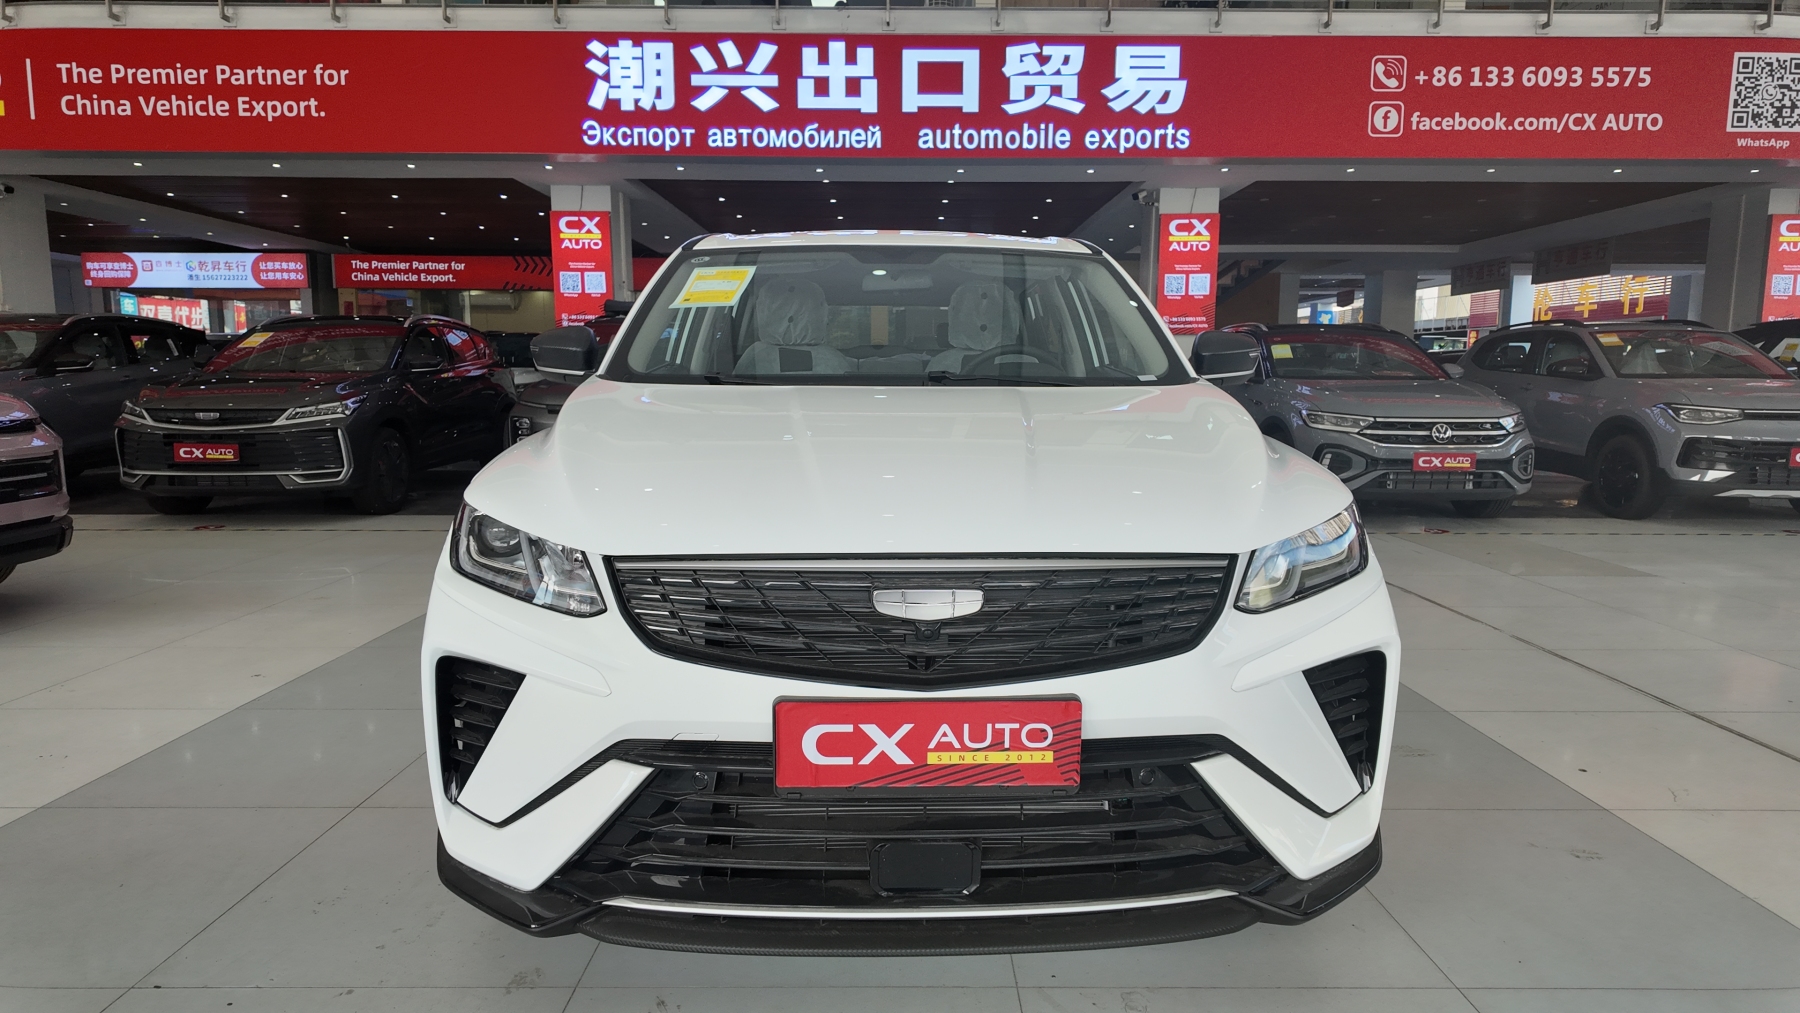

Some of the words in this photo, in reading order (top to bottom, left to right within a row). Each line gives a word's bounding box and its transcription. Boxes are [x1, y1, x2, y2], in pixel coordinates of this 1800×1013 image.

[56, 62, 102, 84] The
[110, 63, 208, 84] Premier
[215, 65, 307, 85] Partner
[313, 64, 349, 85] for
[585, 38, 1188, 115] 潮兴出口贸易
[1414, 66, 1462, 86] +86
[1469, 66, 1515, 86] 133
[1521, 66, 1583, 87] 6093
[1590, 66, 1652, 87] 5575
[60, 94, 132, 115] China
[138, 95, 230, 117] Vehicle
[237, 96, 326, 121] Export.
[1410, 112, 1597, 133] facebook.com/CX
[1602, 113, 1664, 131] AUTO
[582, 120, 695, 151] Экспорт
[707, 123, 882, 149] автомобилей
[917, 122, 1071, 149] automobile
[1084, 122, 1191, 153] exports
[1737, 138, 1790, 149] WhatsApp
[558, 216, 601, 234] CX
[1168, 218, 1211, 236] CX
[1780, 220, 1800, 237] C
[561, 239, 602, 249] AUTO
[1168, 241, 1211, 251] AUTO
[1778, 242, 1800, 251] AU
[351, 260, 369, 269] The
[371, 260, 410, 269] Premier
[412, 261, 449, 270] Partner
[451, 261, 465, 270] for
[351, 272, 380, 281] China
[382, 272, 418, 282] Vehicle
[420, 273, 456, 283] Export.
[179, 448, 204, 458] CX
[1418, 457, 1443, 467] CX
[802, 724, 915, 765] CX
[927, 723, 1054, 749] AUTO
[937, 754, 990, 762] SINCE
[1005, 753, 1048, 762] 2012
